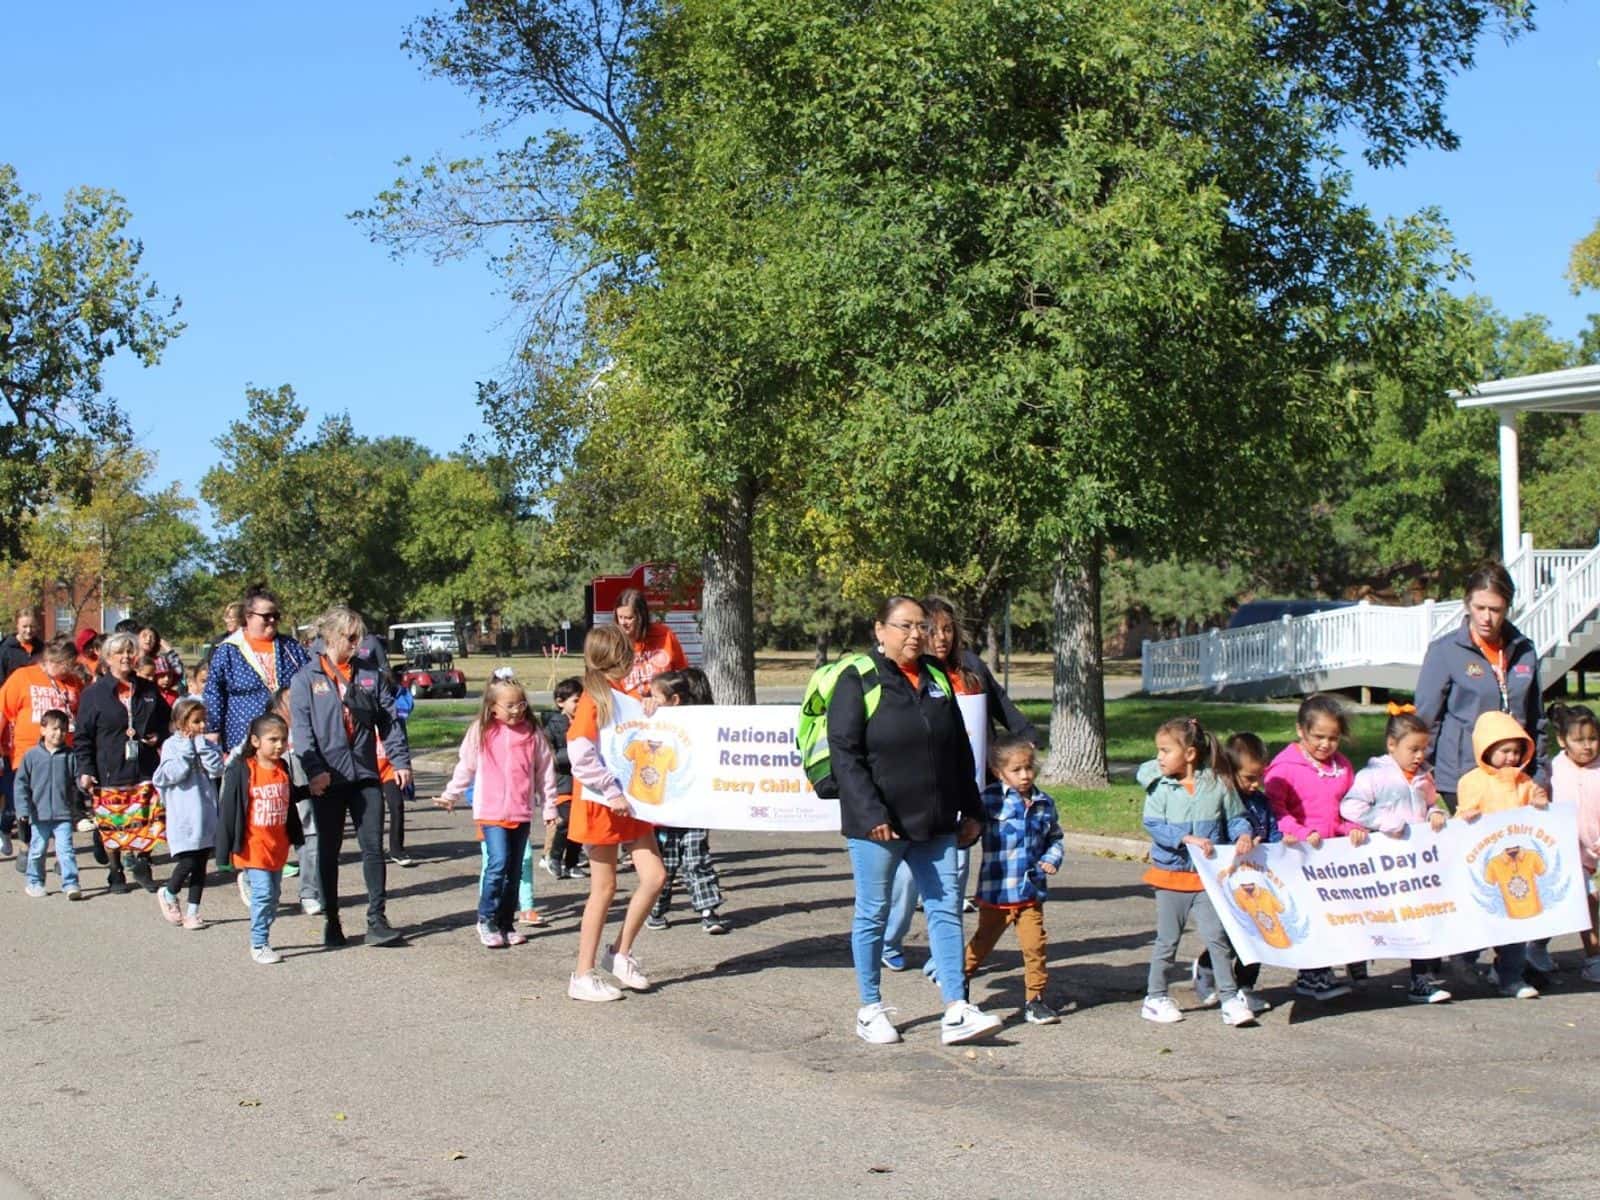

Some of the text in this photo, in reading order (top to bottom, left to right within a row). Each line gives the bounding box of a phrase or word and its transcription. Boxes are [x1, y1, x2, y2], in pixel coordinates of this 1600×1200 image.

[717, 727, 795, 743] National
[719, 750, 803, 767] Rememb
[712, 778, 754, 794] Every
[760, 778, 801, 793] Child
[1465, 823, 1556, 864] Orange Shirt Day
[1301, 844, 1439, 882] National Day of
[1316, 873, 1442, 902] Remembrance
[1325, 911, 1365, 926] Every
[1400, 901, 1457, 922] Matters
